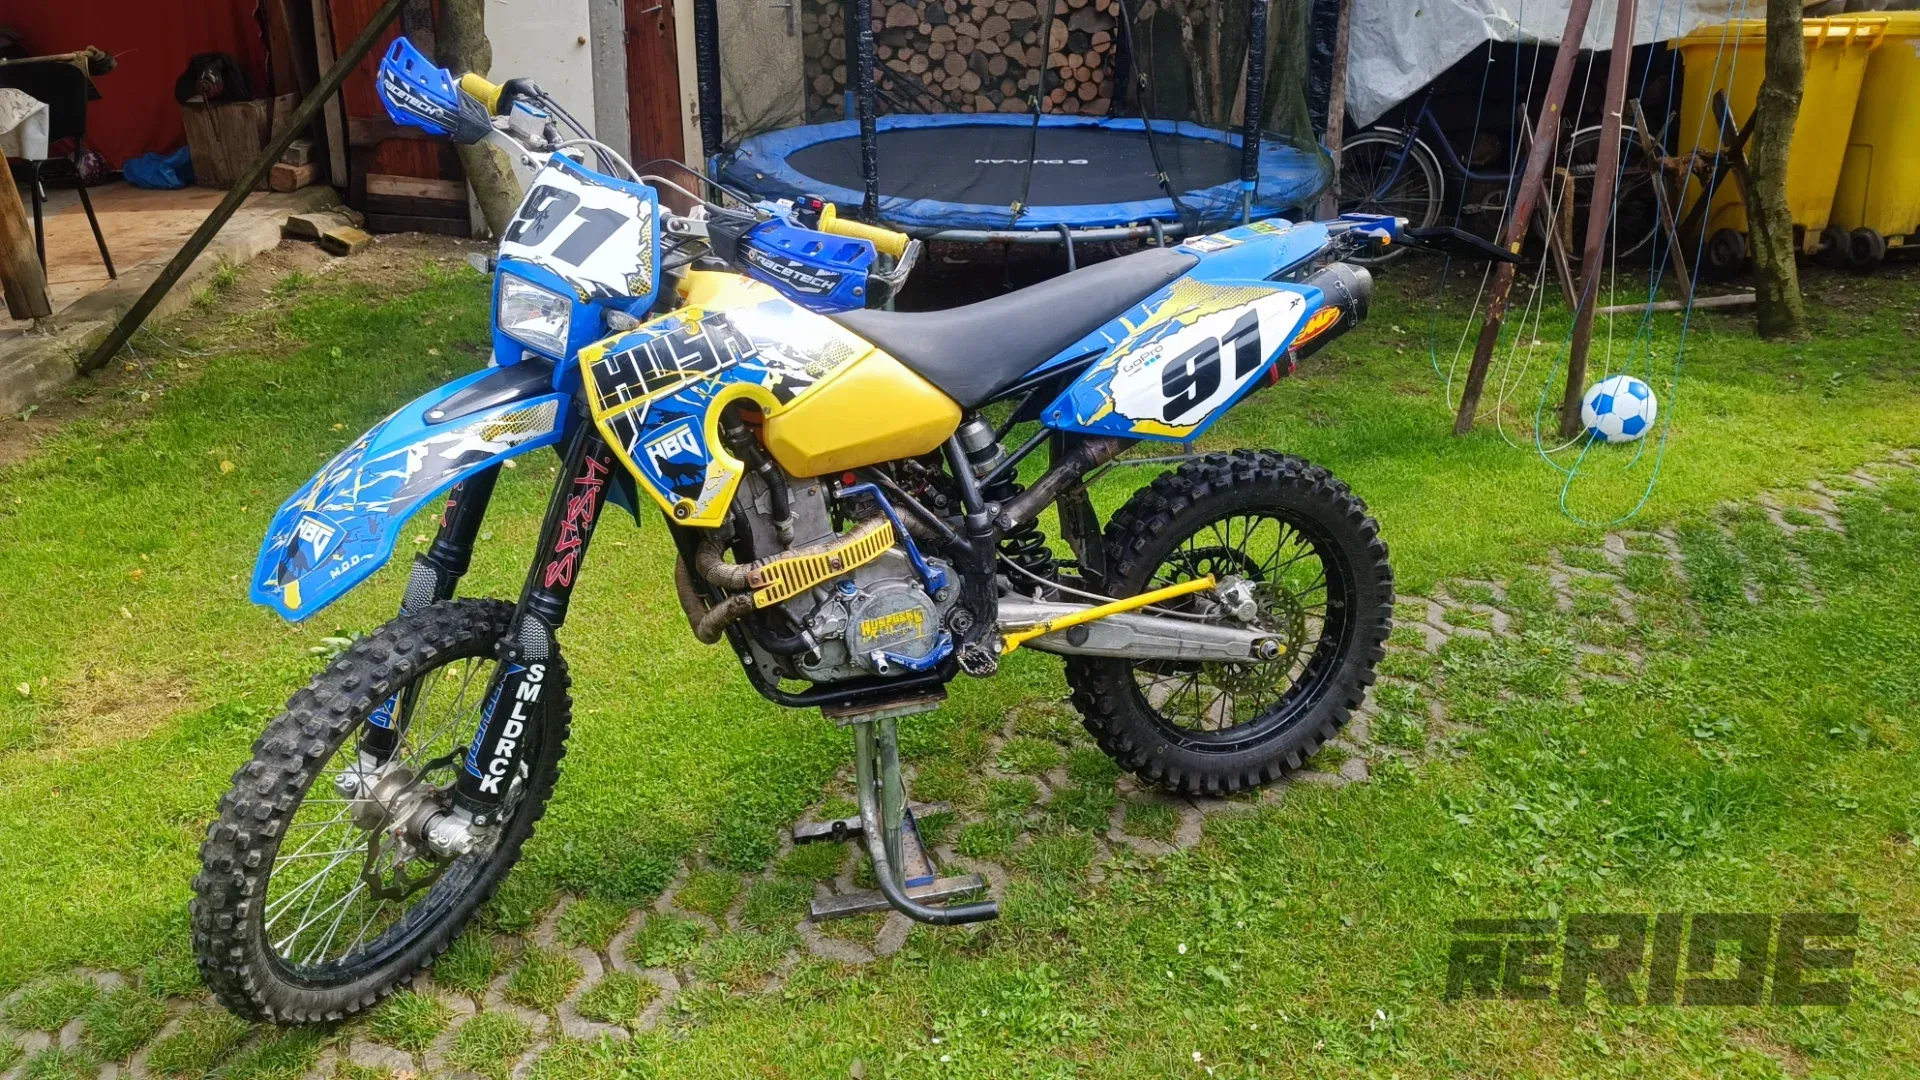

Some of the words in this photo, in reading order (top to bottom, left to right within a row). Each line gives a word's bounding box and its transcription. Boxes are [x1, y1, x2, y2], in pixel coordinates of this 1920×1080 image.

[504, 184, 630, 267] 91
[1123, 345, 1163, 372] GoPro
[1162, 308, 1262, 422] 91
[479, 664, 546, 794] SMLDRCK
